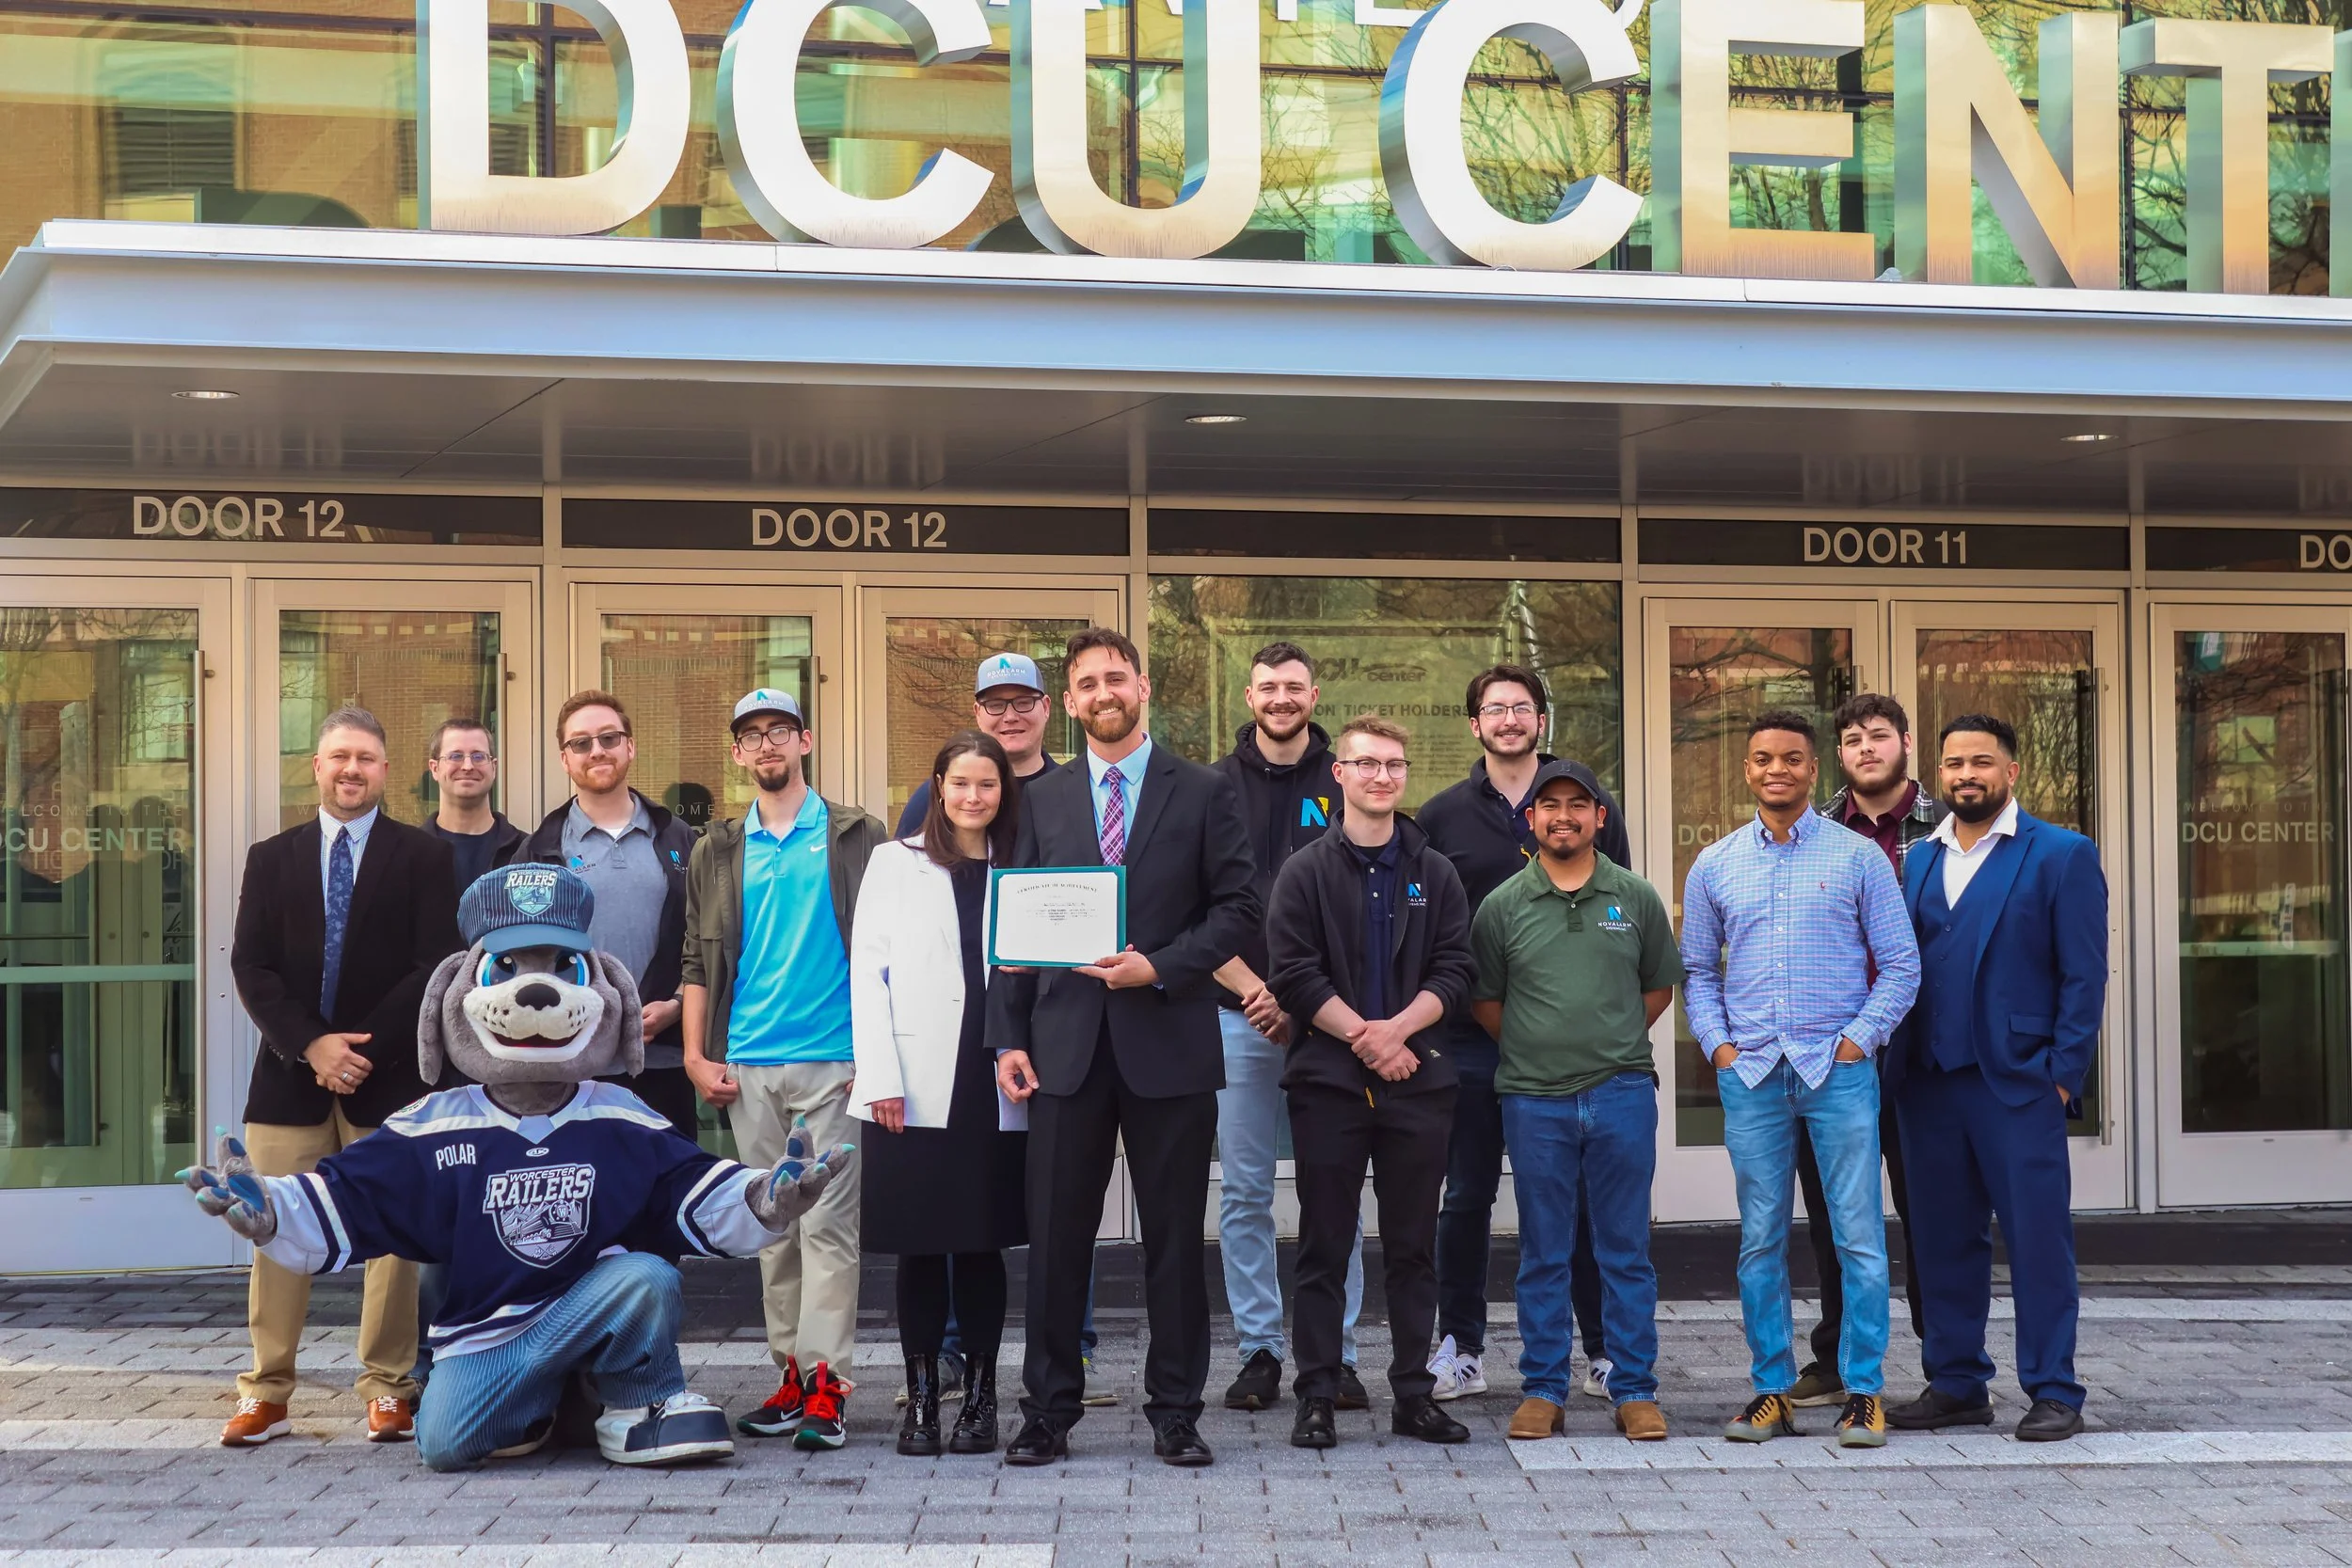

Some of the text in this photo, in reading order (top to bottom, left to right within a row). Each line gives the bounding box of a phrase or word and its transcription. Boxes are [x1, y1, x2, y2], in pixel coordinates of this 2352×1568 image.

[420, 0, 2352, 295] DCU CENT
[133, 496, 345, 537] DOOR 12
[752, 508, 947, 547] DOOR 12
[1804, 527, 1966, 564] DOOR 11
[2299, 534, 2352, 570] DO
[1367, 669, 1427, 682] center
[1343, 705, 1396, 717] TICKET
[143, 804, 183, 816] THE
[0, 827, 187, 853] CU CENTER
[2182, 821, 2335, 844] DCU CENTER
[506, 872, 558, 887] RAILERS
[435, 1143, 477, 1171] POLAR
[509, 1166, 577, 1183] WORCESTER
[486, 1167, 595, 1210] RAILERS
